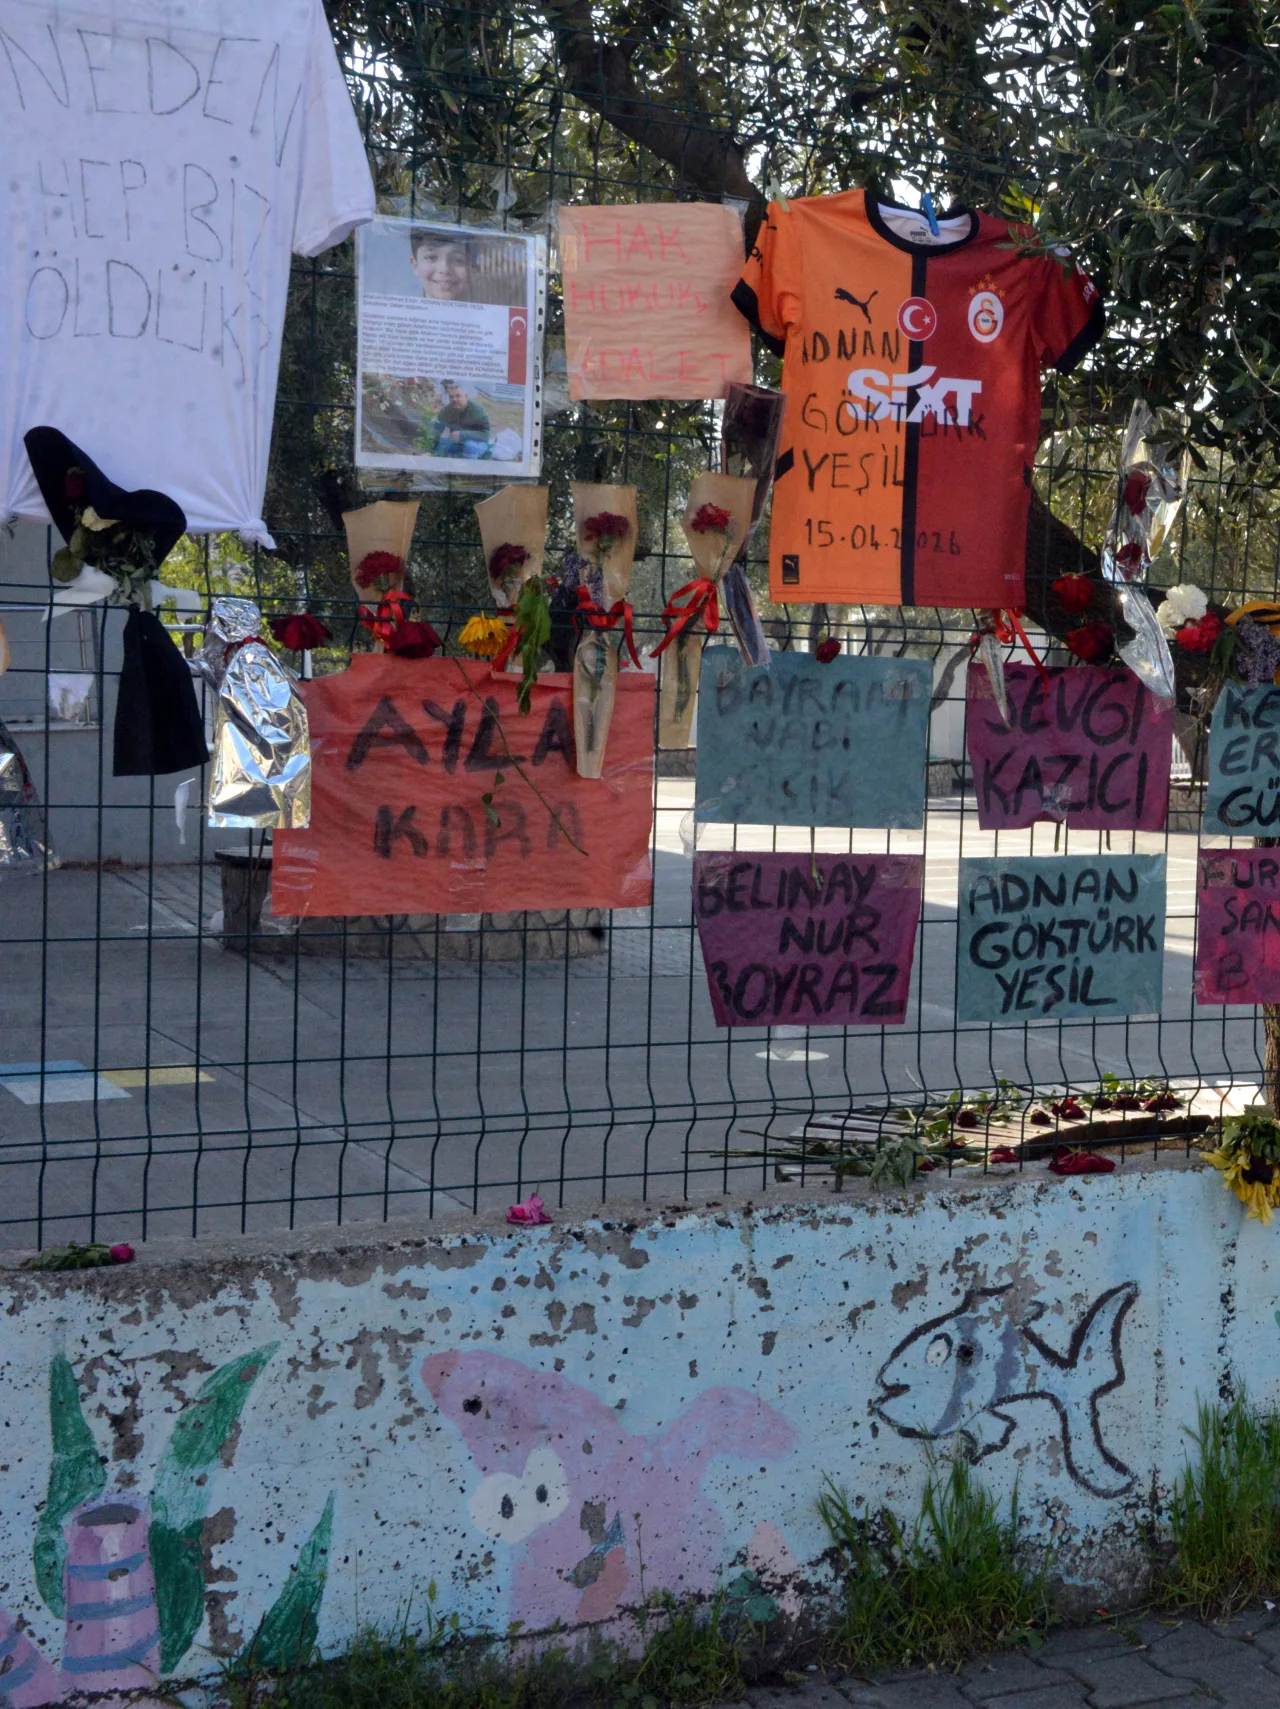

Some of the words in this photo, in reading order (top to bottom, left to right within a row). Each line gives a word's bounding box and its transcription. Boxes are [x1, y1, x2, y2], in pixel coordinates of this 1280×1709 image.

[0, 22, 302, 168] NEDEN
[37, 157, 147, 242] HEP
[579, 346, 735, 385] ADALET
[801, 327, 901, 365] ADNAN
[801, 389, 987, 442] GÖKTÜRK
[802, 444, 905, 496] YEŞİL
[345, 695, 575, 775] AYLA
[982, 747, 1149, 820] KAZICI
[968, 867, 1139, 916] ADNAN
[778, 905, 882, 956] NUR
[968, 906, 1158, 971] GÖKTÜRK
[994, 956, 1118, 1016] YEŞİL
